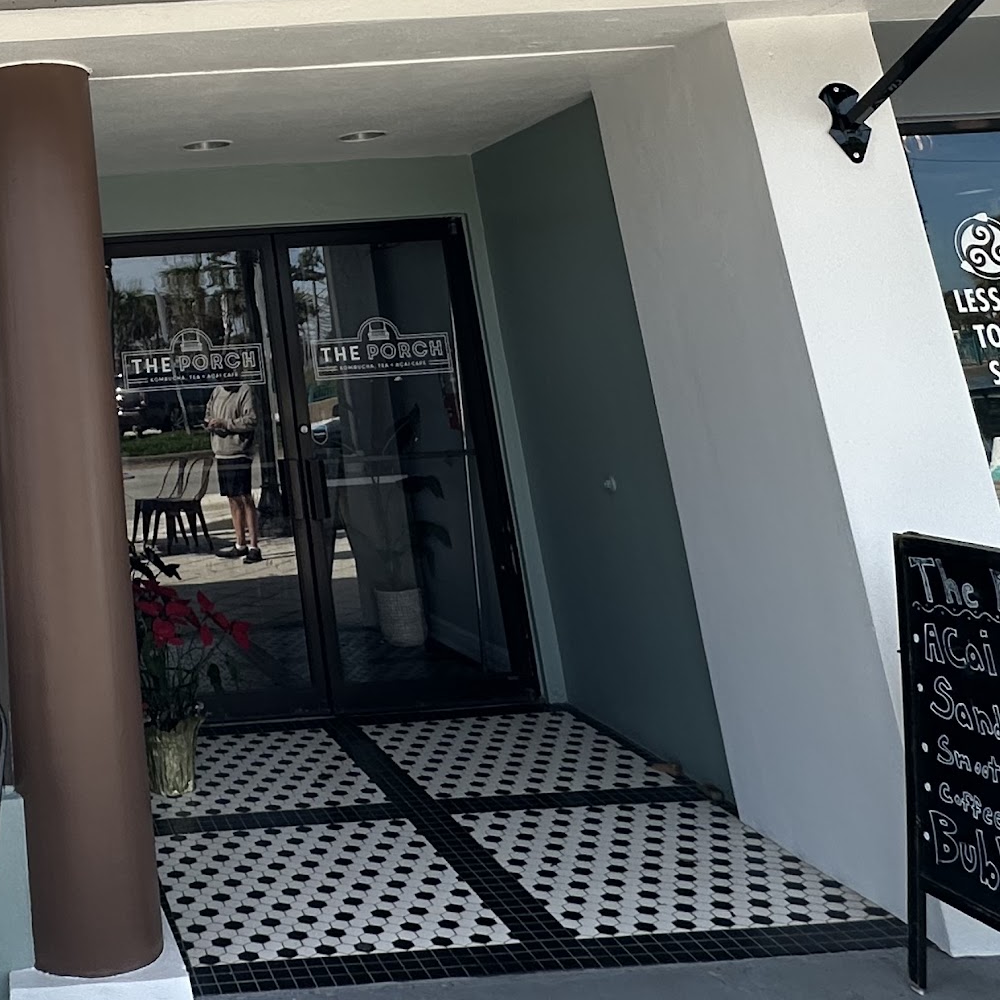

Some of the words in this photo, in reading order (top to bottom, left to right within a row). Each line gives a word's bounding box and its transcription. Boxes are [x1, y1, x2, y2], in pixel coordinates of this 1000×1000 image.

[131, 356, 172, 374] THE
[178, 350, 257, 372] PORCH
[320, 345, 361, 363] THE
[366, 340, 443, 361] PORCH
[908, 556, 979, 609] The
[929, 809, 1000, 891] Bub
